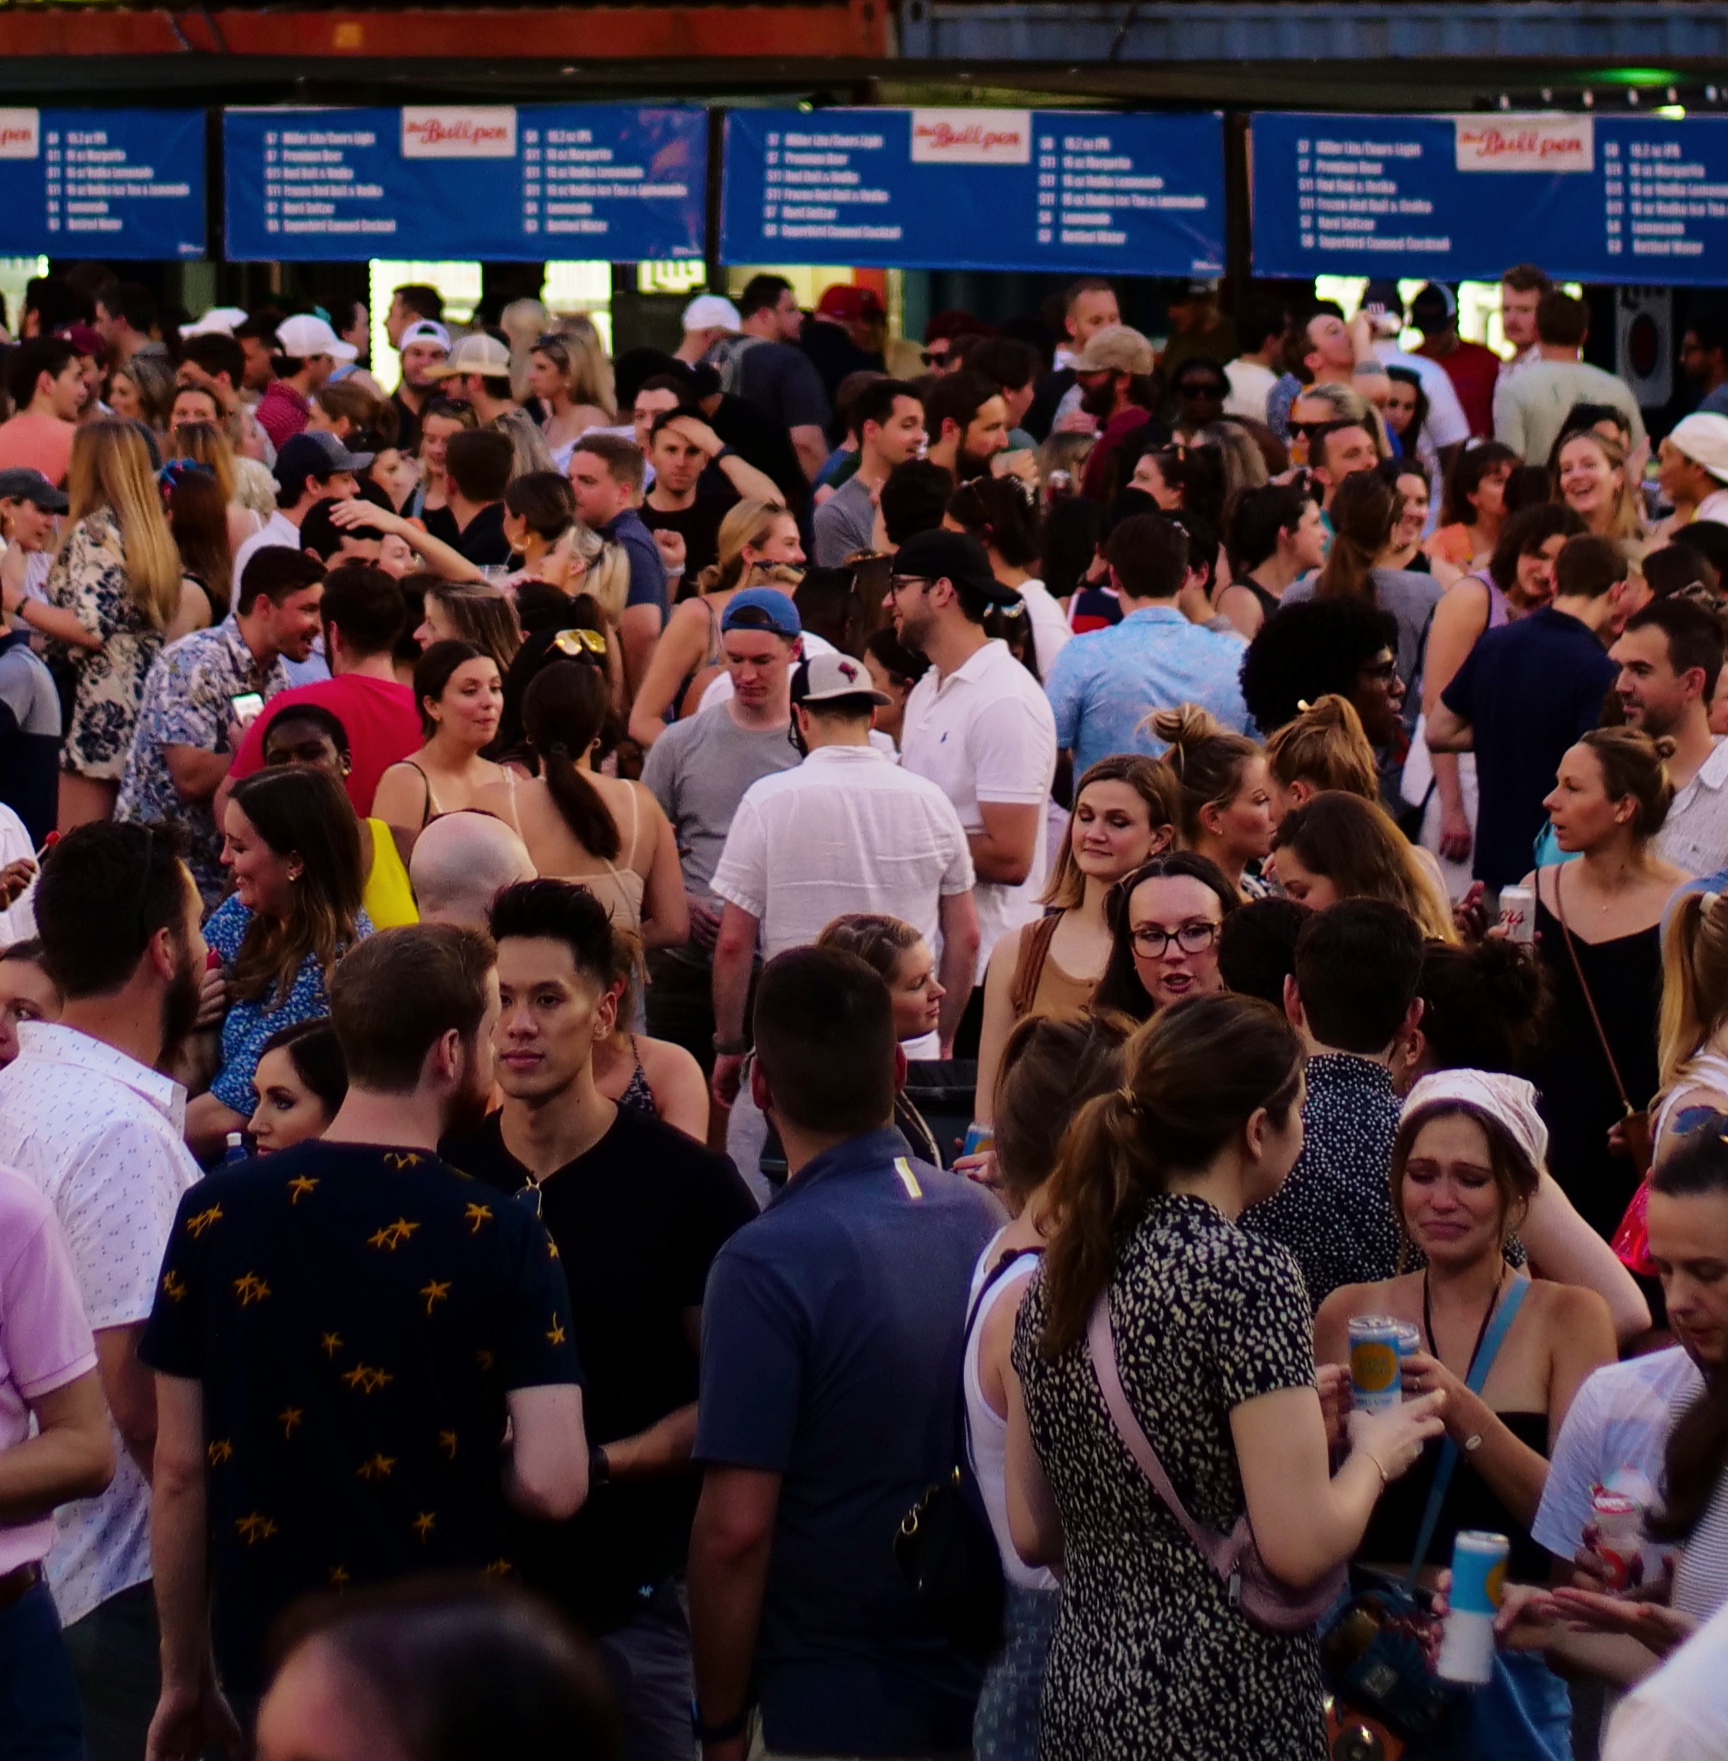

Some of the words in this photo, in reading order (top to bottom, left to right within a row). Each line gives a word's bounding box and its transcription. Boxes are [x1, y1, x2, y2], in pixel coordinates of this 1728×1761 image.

[420, 119, 507, 145] Bullpen
[929, 122, 1020, 150] Bullpen
[1476, 126, 1583, 158] Bullpen
